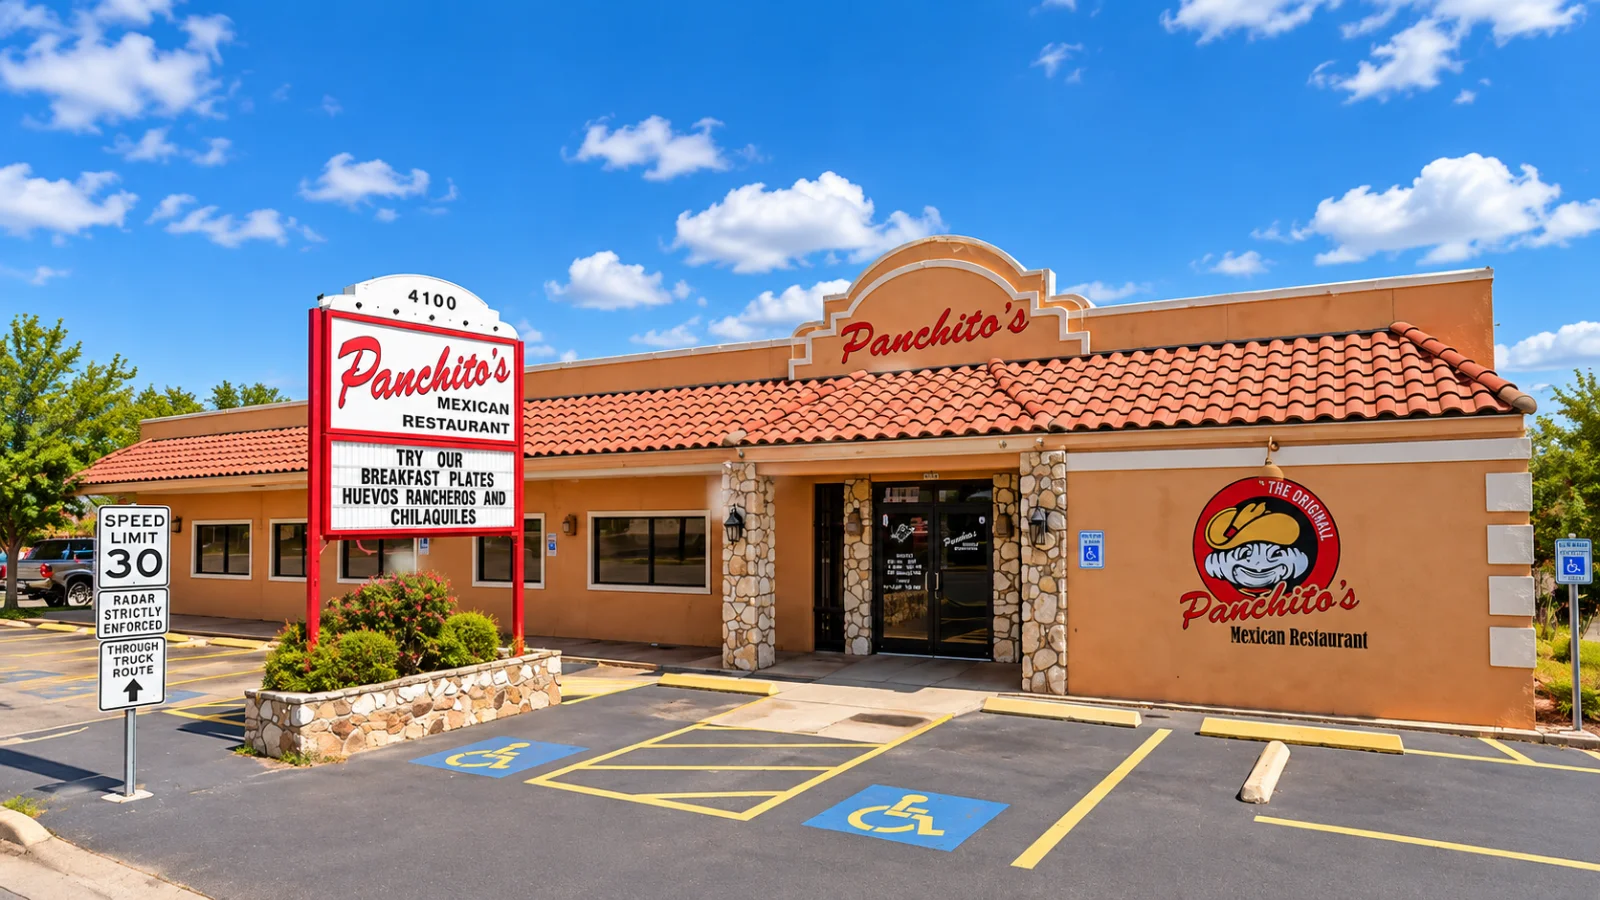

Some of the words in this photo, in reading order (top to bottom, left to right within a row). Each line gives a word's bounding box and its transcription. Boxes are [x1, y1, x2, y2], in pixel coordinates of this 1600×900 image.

[408, 289, 456, 310] 4100
[841, 302, 1030, 364] Panchito's
[338, 335, 511, 409] Panchito's
[437, 396, 510, 416] MEXICAN
[402, 414, 510, 435] RESTAURANT
[396, 449, 423, 466] TRY
[437, 451, 463, 468] OUR
[361, 468, 440, 486] BREAKFAST
[449, 471, 494, 487] PLATES
[342, 488, 398, 505] HUEVOS
[406, 489, 476, 505] RANCHEROS
[483, 491, 506, 506] AND
[104, 514, 165, 528] SPEED
[390, 509, 477, 526] CHILAQUILES
[111, 532, 158, 544] LIMIT
[105, 548, 163, 579] 30
[113, 593, 155, 606] RADAR
[1180, 579, 1360, 630] Panchito's
[104, 606, 162, 621] STRICTLY
[103, 619, 163, 634] ENFORCED
[1230, 626, 1285, 645] Mexican
[1289, 628, 1368, 649] Restaurant
[107, 641, 159, 655] THROUGH
[113, 653, 154, 667] TRUCK
[112, 665, 154, 678] ROUTE
